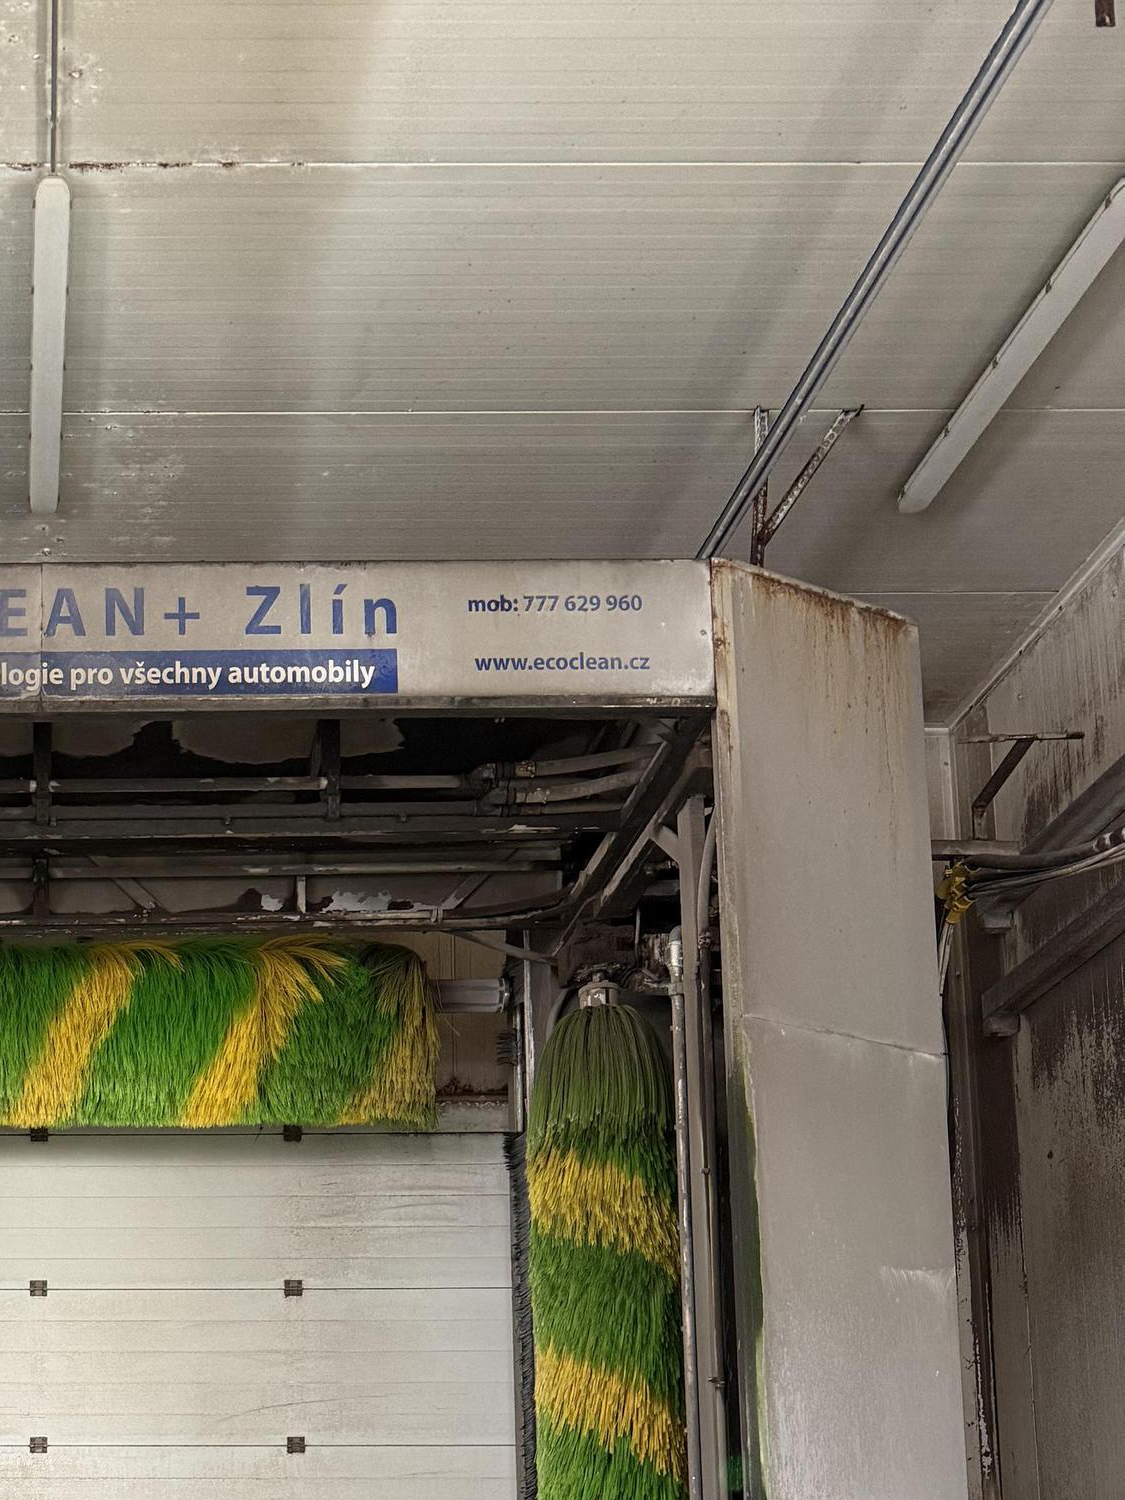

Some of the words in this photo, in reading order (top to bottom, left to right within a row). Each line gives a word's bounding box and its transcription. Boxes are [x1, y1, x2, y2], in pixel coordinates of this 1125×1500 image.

[244, 584, 398, 636] Zlín
[468, 594, 519, 613] mob:
[523, 595, 560, 612] 777
[564, 595, 601, 612] 629
[605, 594, 643, 612] 960
[474, 651, 651, 672] www.ecoclean.cz
[70, 665, 113, 691] pro
[120, 660, 222, 690] všechny
[228, 659, 375, 689] automobily
